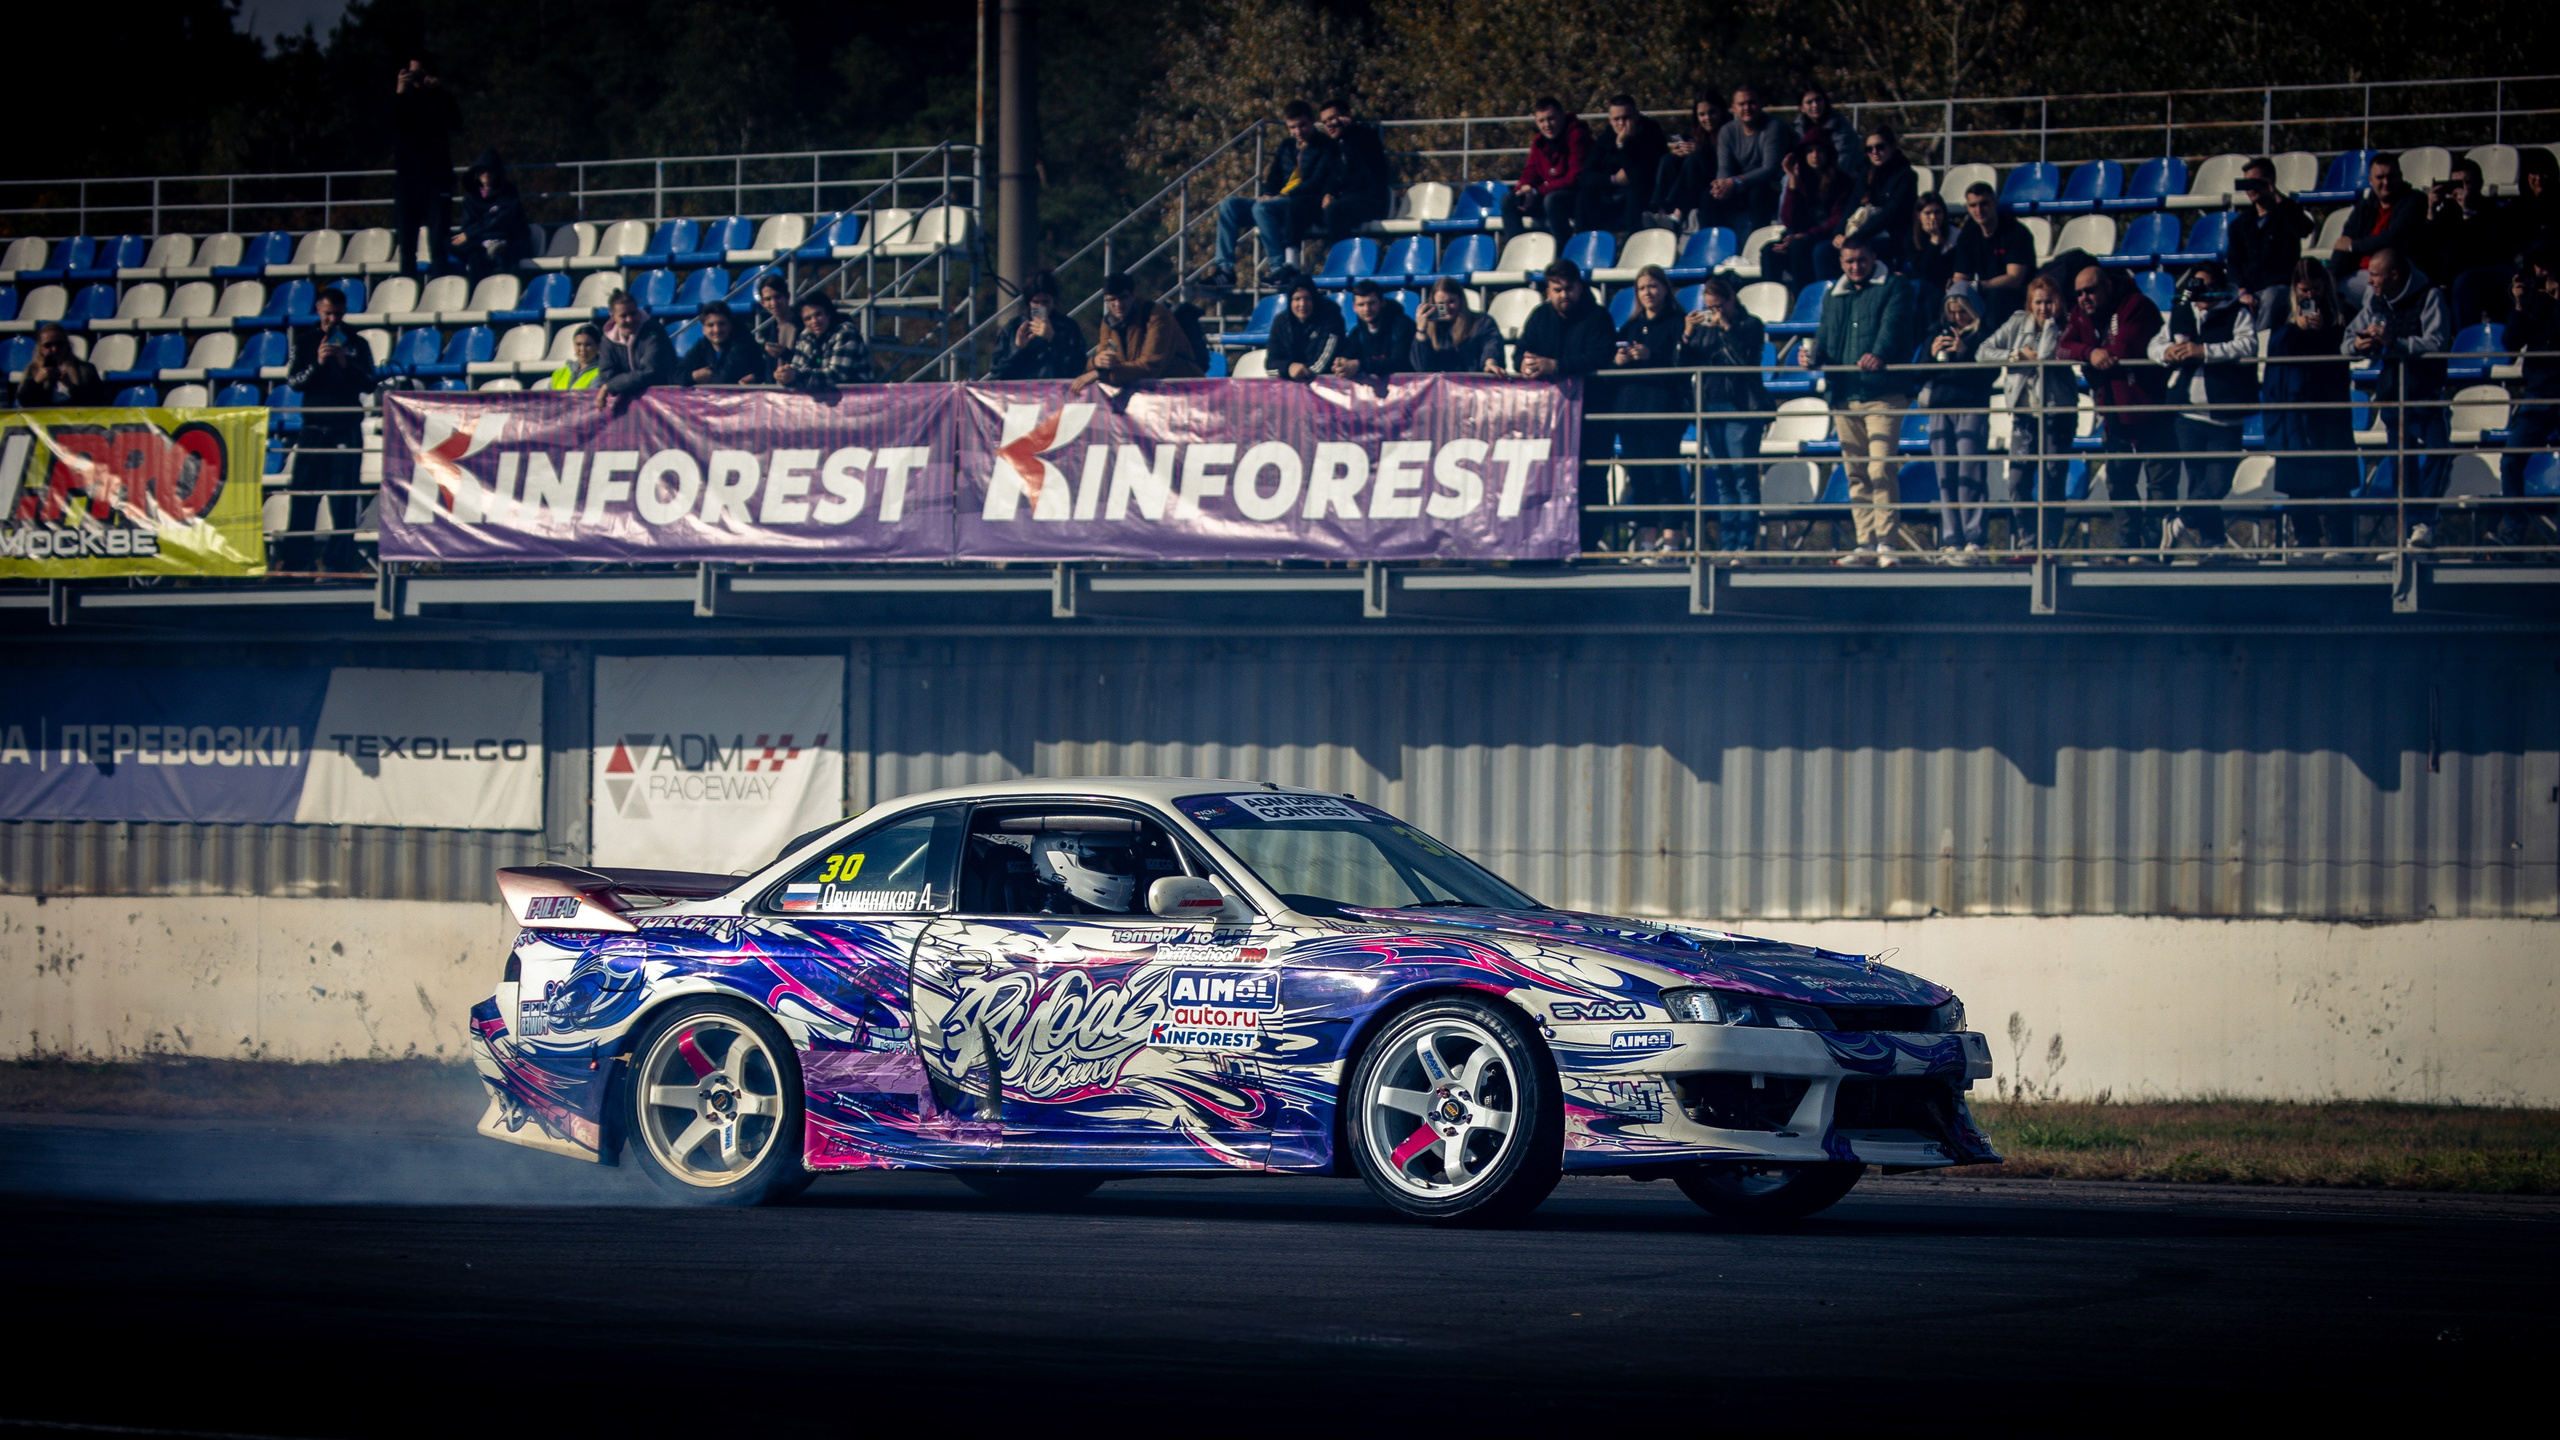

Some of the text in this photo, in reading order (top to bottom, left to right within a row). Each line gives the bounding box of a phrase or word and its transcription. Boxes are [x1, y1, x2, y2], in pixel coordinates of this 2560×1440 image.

[404, 412, 929, 525] KINFOREST
[982, 402, 1552, 522] KINFOREST
[0, 529, 157, 555] МОСКВЕ
[61, 725, 300, 766] ПЕРЕВОЗКИ
[330, 734, 528, 761] TEXOL.CO
[652, 734, 744, 772] ADM
[650, 776, 778, 799] RACEWAY
[1244, 797, 1288, 807] ADM
[1258, 806, 1356, 818] CONTEST
[819, 853, 865, 882] 30
[916, 883, 935, 910] А.
[1172, 977, 1274, 1003] AIMOL
[1174, 1007, 1256, 1027] auto.ru
[1149, 1023, 1255, 1047] KINFOREST
[1614, 1034, 1670, 1047] AIMOL
